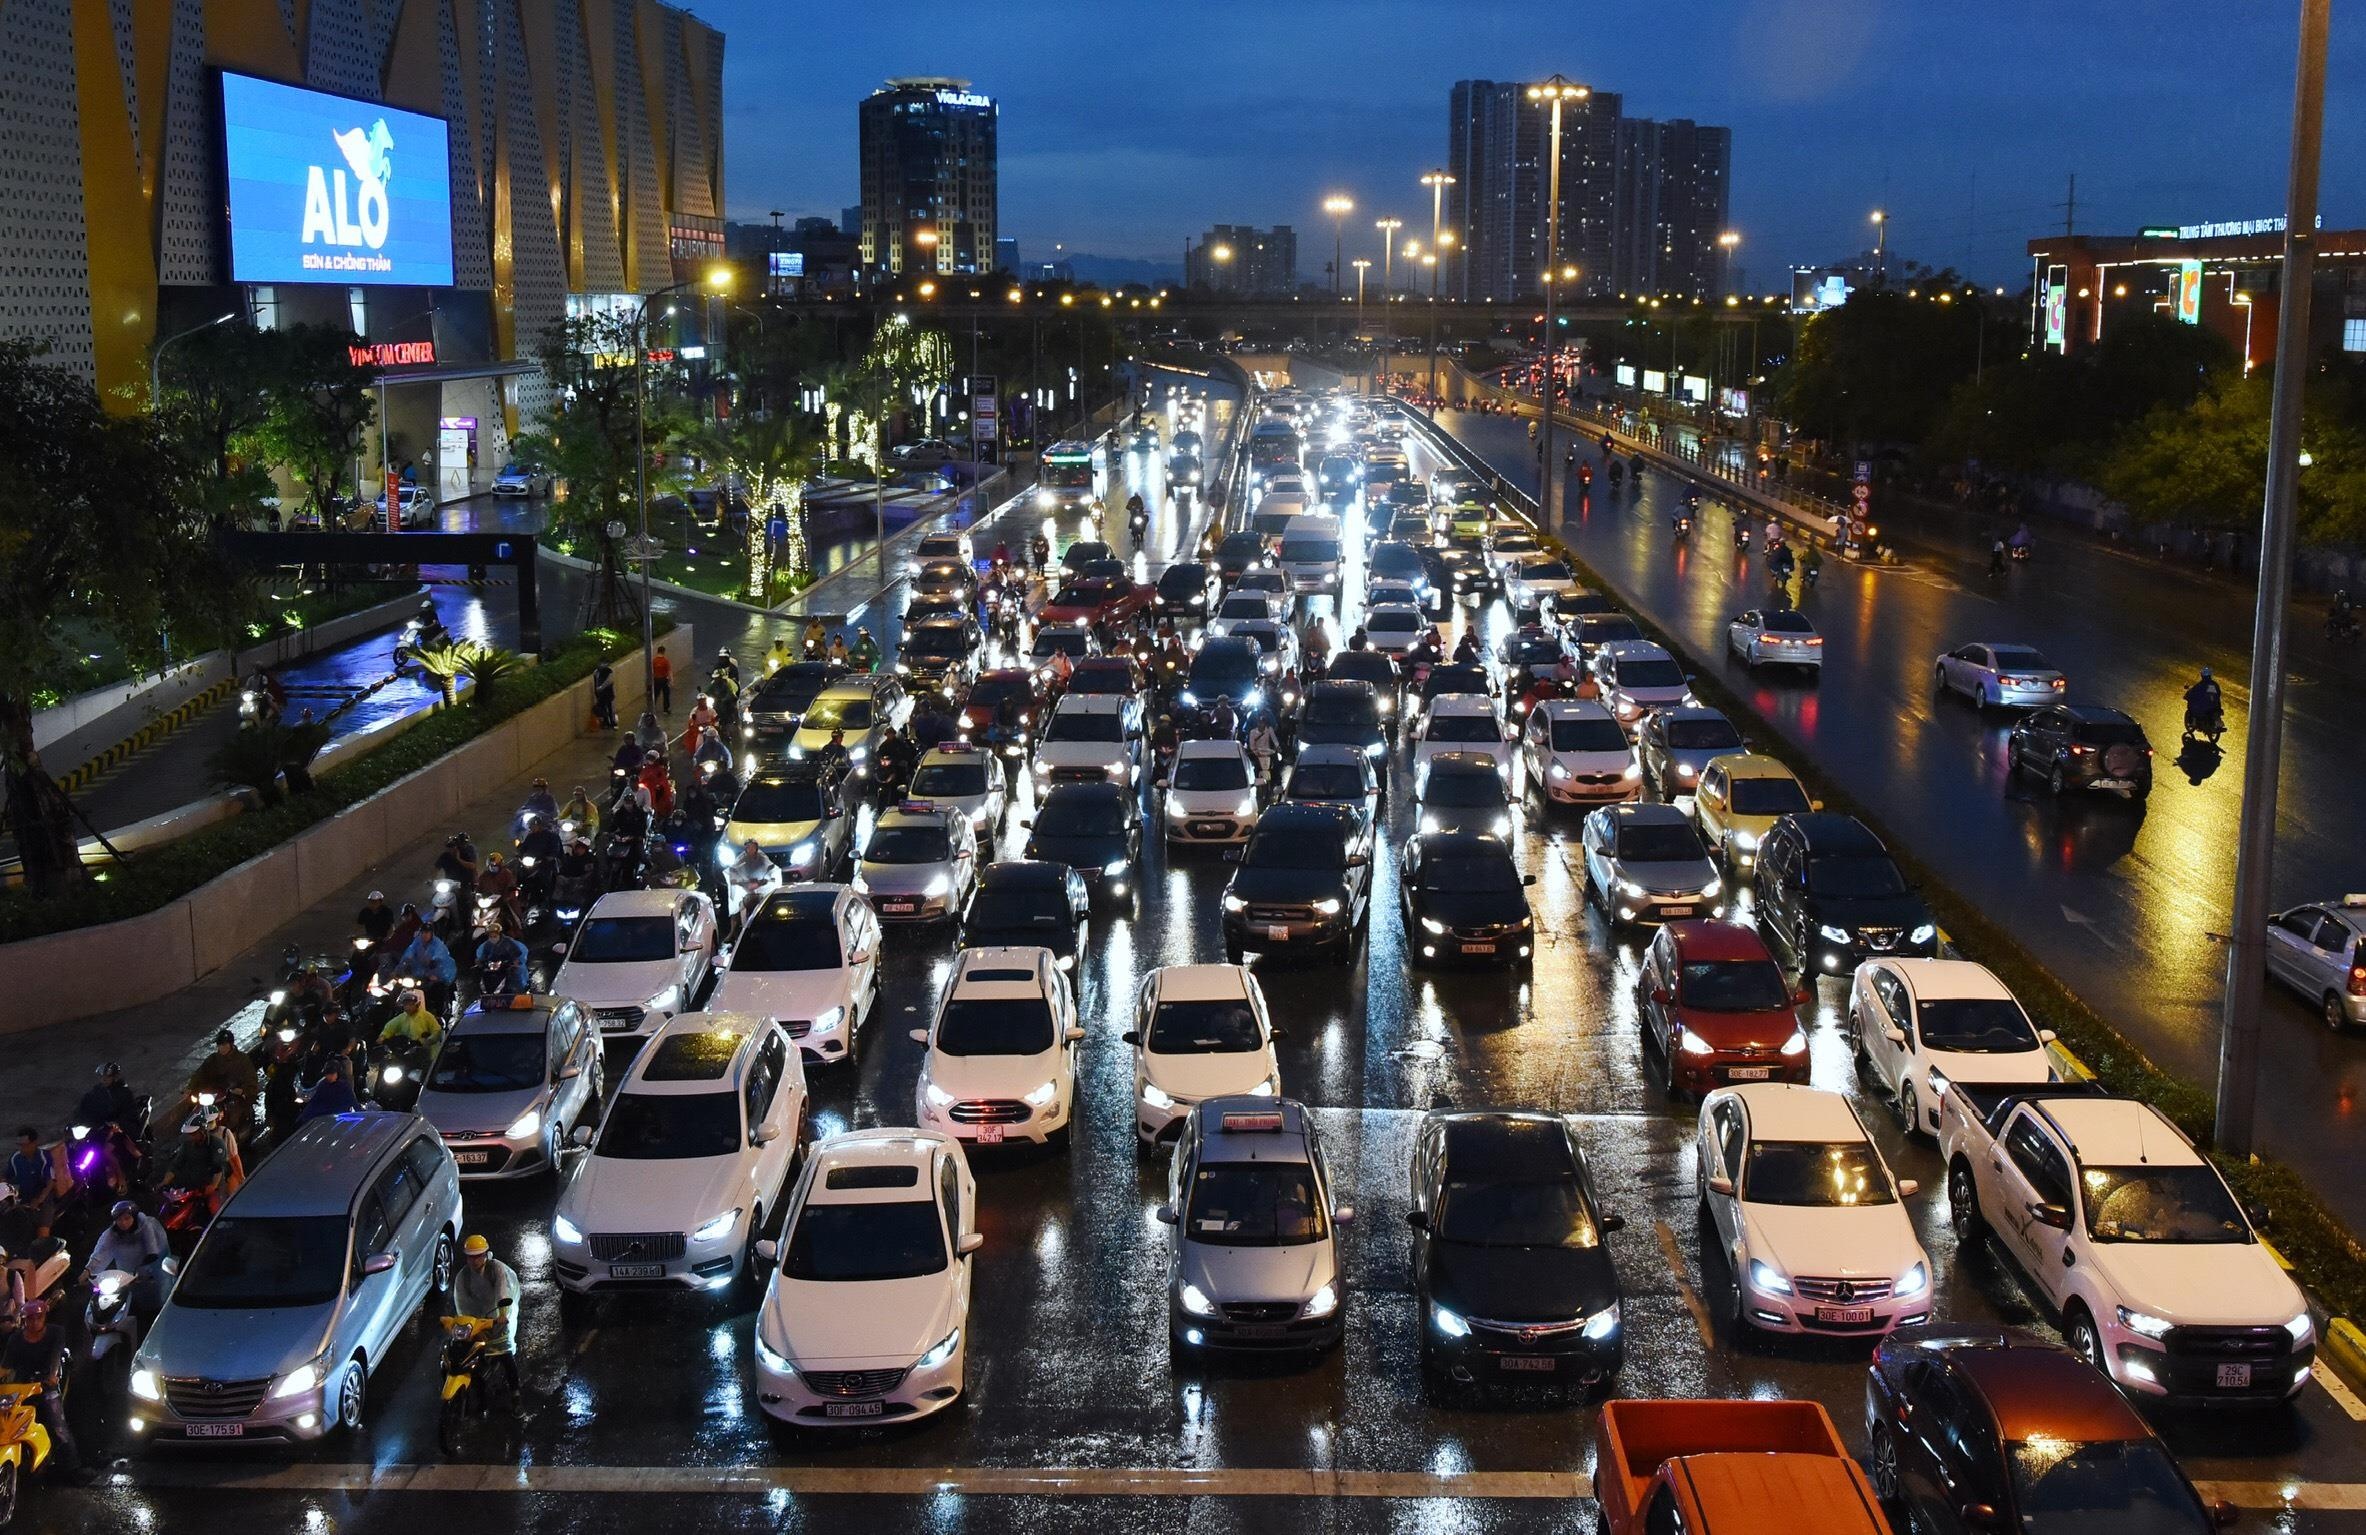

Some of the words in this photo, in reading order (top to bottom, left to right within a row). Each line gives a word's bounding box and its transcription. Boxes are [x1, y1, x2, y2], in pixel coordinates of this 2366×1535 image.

[302, 165, 389, 249] ALO
[394, 341, 435, 364] CENTER
[2225, 1366, 2243, 1376] 29C
[187, 1424, 242, 1436] 30E-175.91
